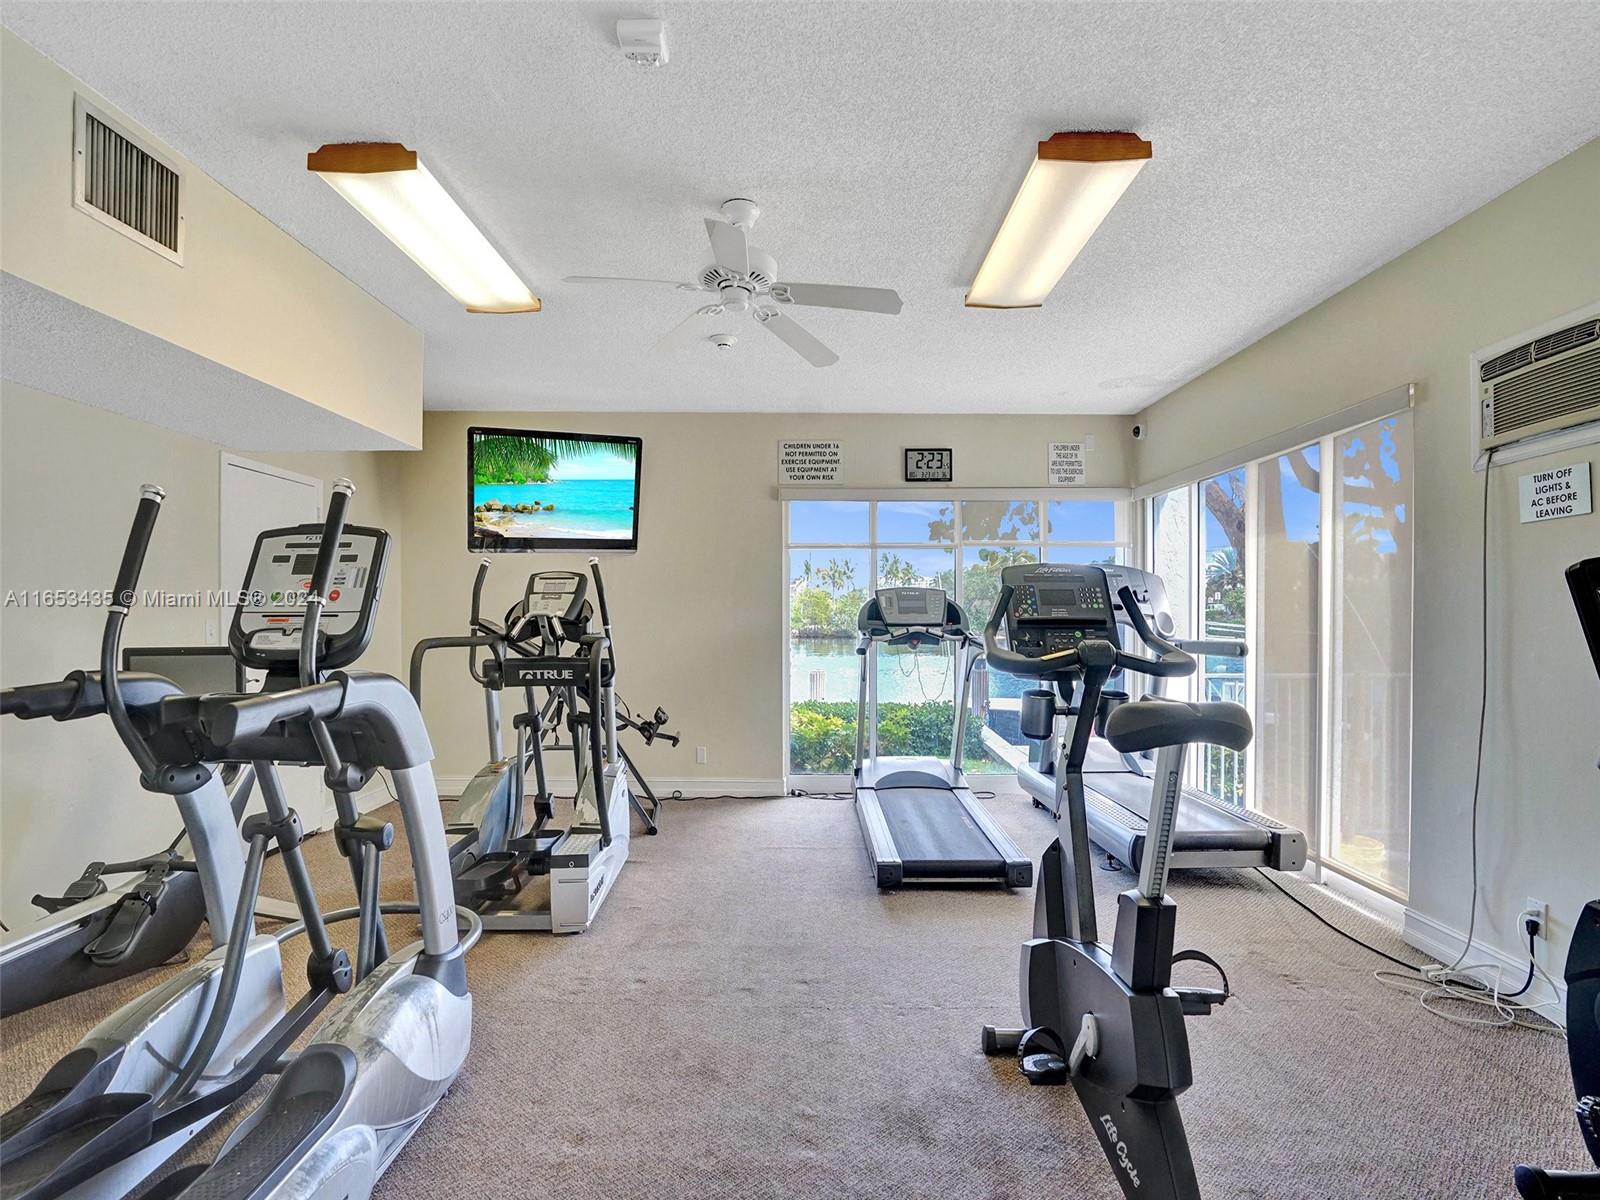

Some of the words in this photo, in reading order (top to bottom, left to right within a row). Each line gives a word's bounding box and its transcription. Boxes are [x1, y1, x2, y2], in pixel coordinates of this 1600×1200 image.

[916, 452, 943, 469] 2:23
[1533, 472, 1553, 483] TURN
[1556, 468, 1572, 478] OFF
[1536, 482, 1562, 495] LIGHTS
[1565, 481, 1571, 490] &
[1531, 498, 1544, 507] AC
[1546, 492, 1578, 505] BEFORE
[1536, 505, 1573, 518] LEAVING
[533, 670, 573, 680] TRUE
[1100, 1114, 1118, 1143] Life
[1116, 1141, 1140, 1188] Cycle
